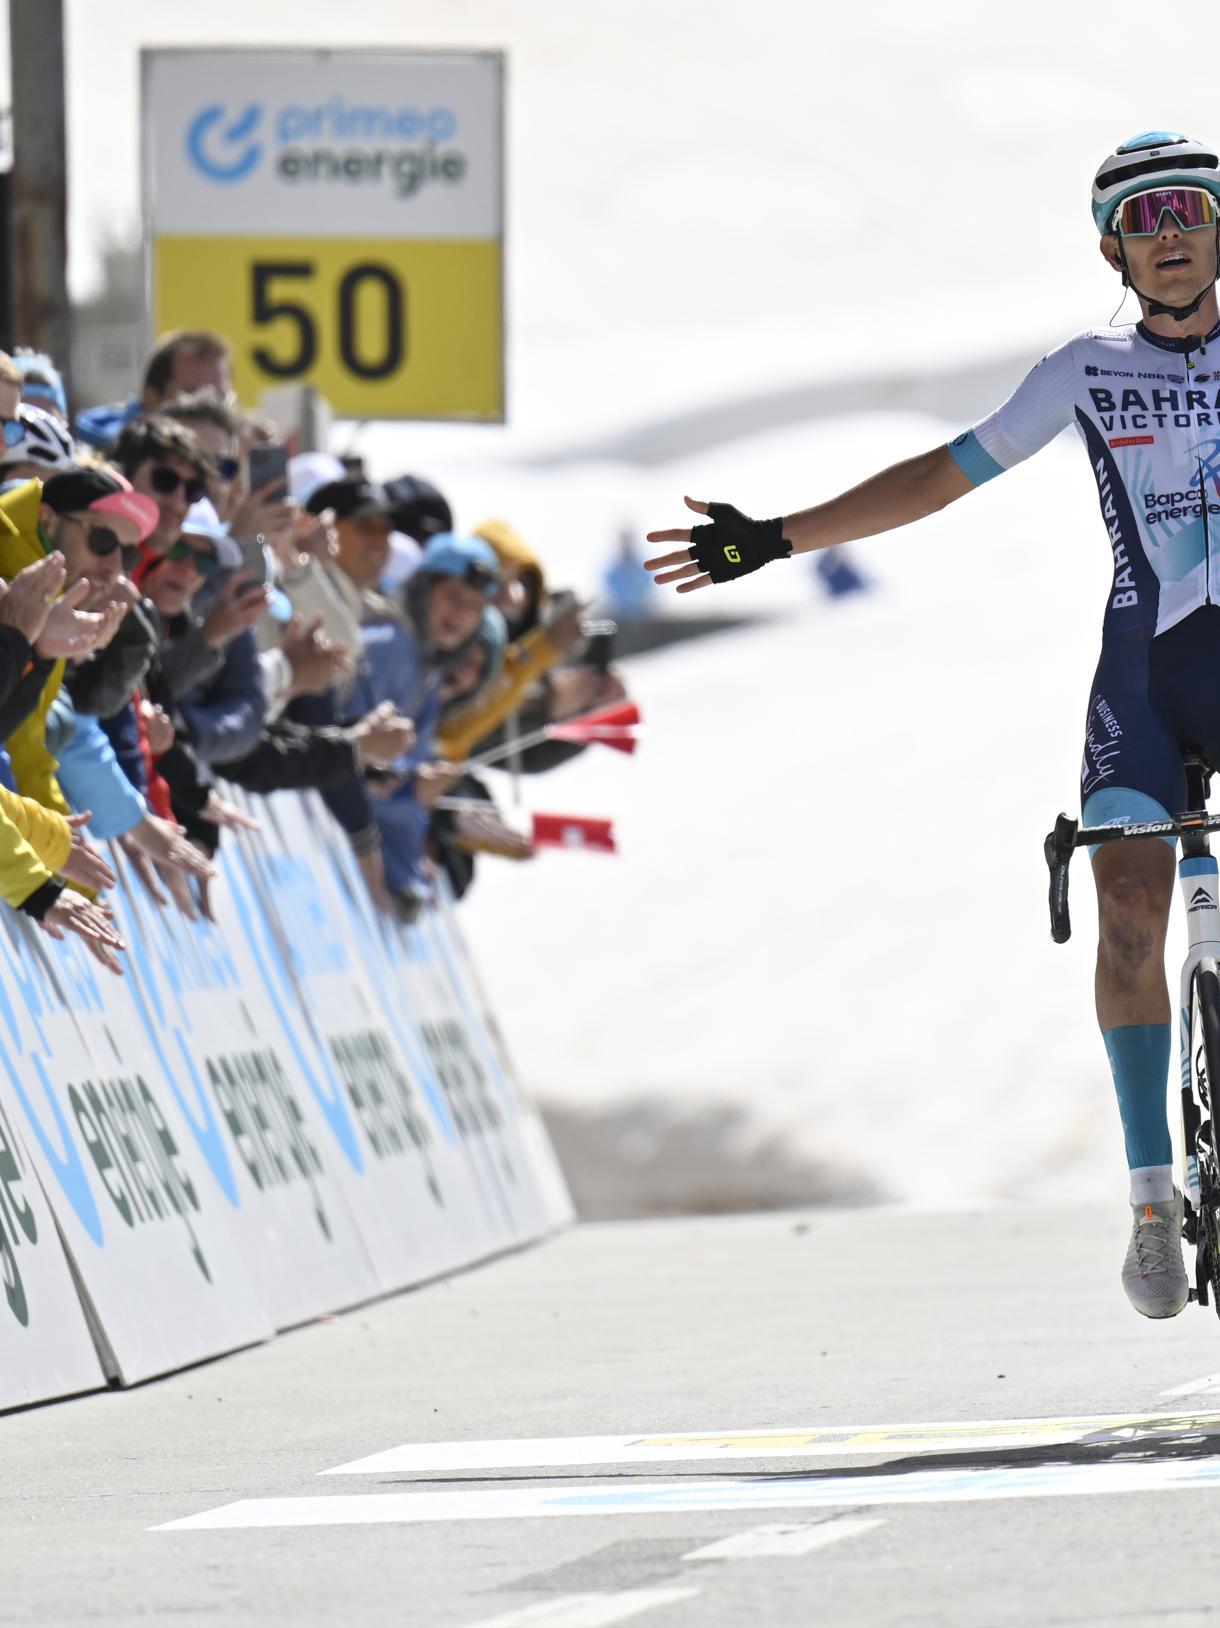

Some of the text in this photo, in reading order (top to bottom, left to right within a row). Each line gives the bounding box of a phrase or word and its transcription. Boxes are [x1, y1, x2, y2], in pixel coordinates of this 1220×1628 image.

[277, 97, 457, 142] primeo
[278, 139, 466, 200] energie
[249, 259, 406, 382] 50
[1101, 369, 1134, 378] BEYON
[1096, 456, 1138, 609] BAHRAIN
[1096, 699, 1123, 738] BUSINESS
